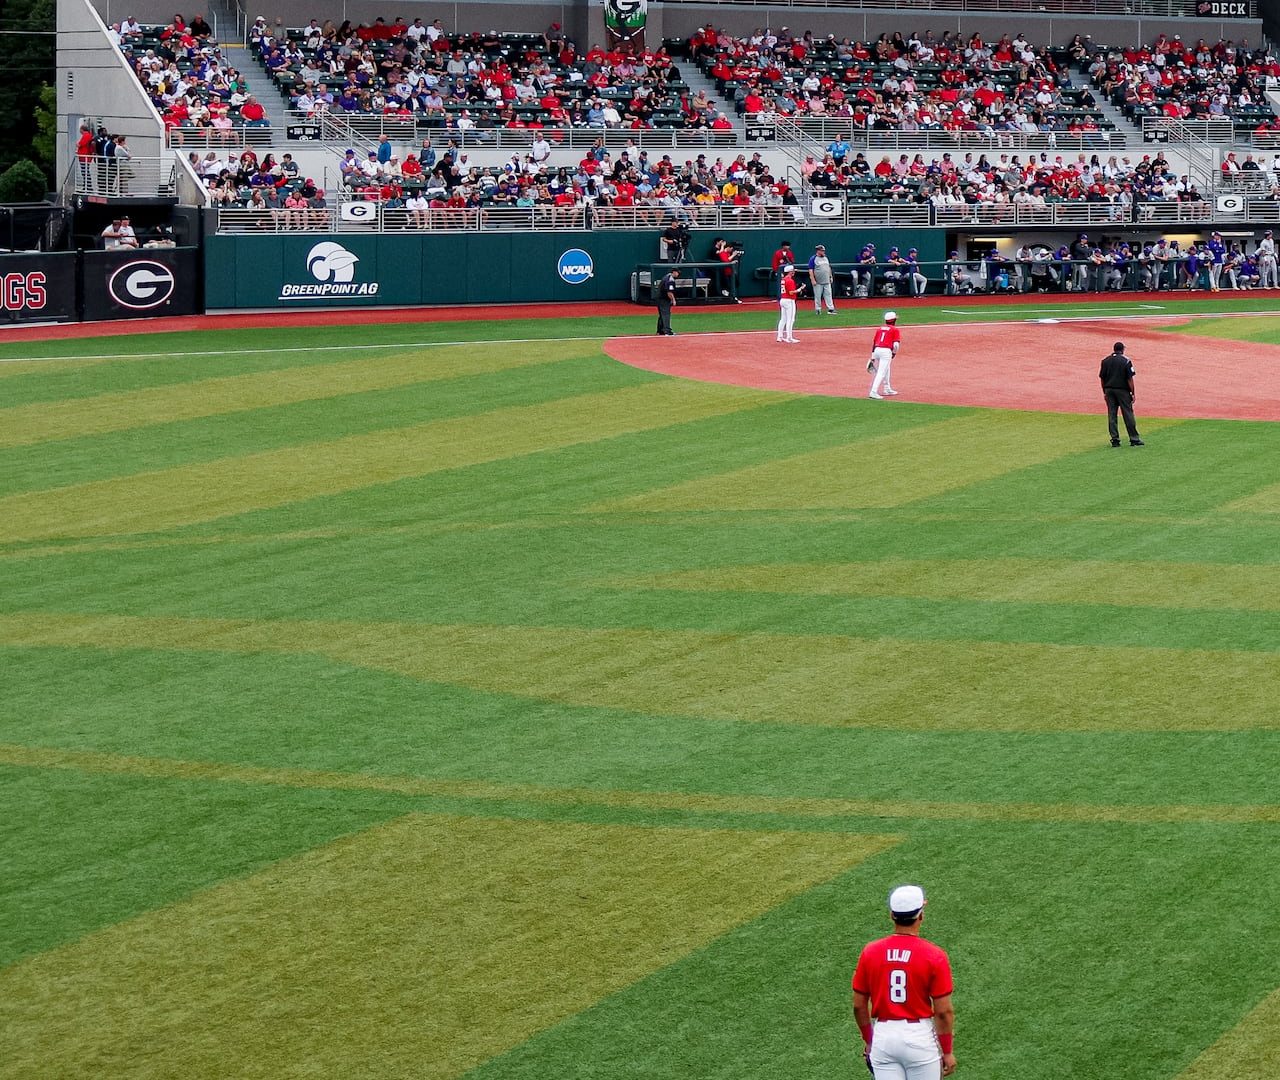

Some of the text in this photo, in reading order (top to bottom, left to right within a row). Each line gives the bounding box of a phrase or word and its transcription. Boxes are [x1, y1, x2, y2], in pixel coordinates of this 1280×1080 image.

[1211, 2, 1246, 15] DECK
[562, 265, 591, 275] NCAA
[357, 282, 379, 295] AG
[886, 948, 912, 963] LUJO
[889, 969, 907, 1003] 8
